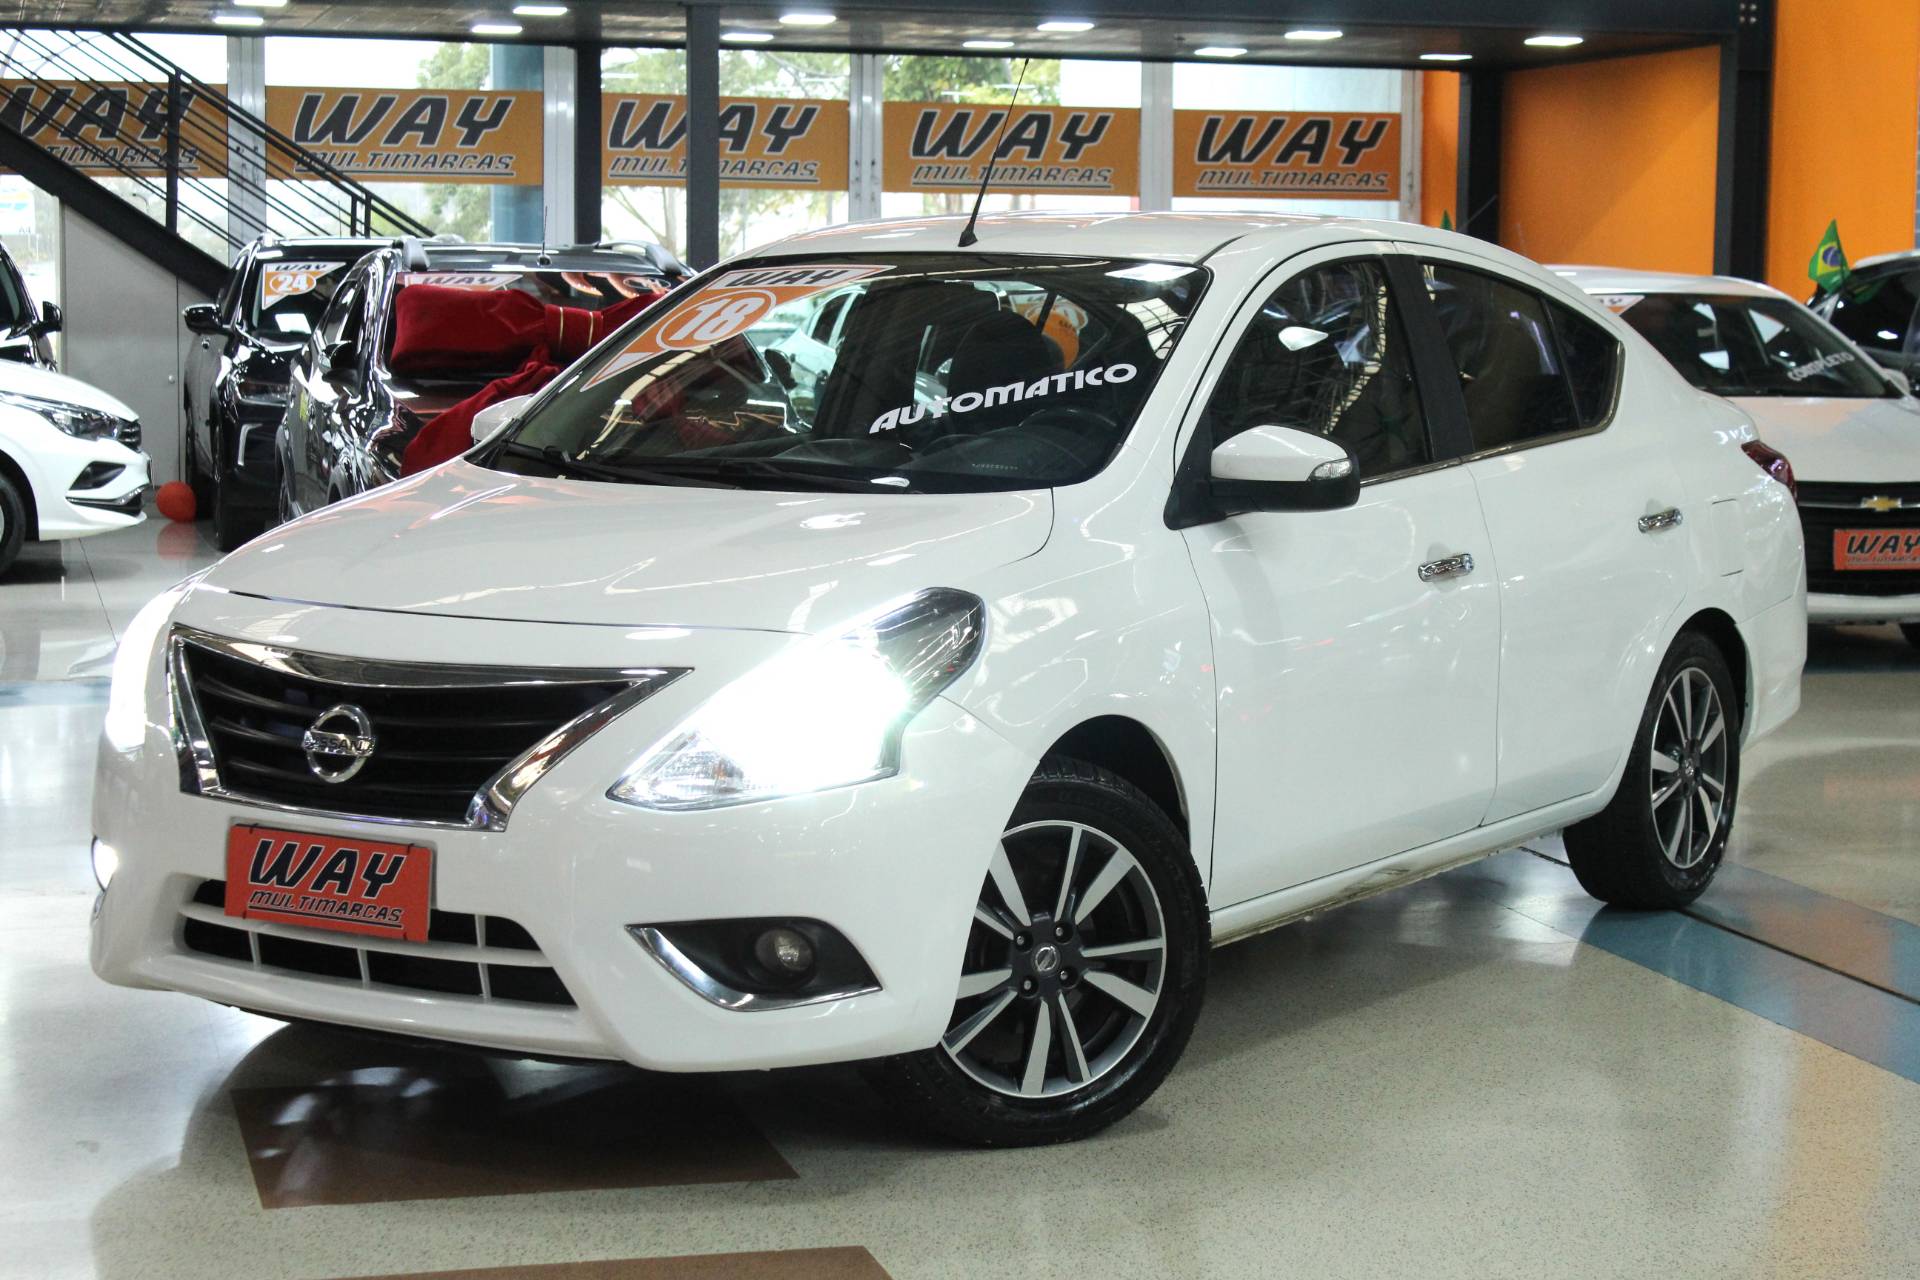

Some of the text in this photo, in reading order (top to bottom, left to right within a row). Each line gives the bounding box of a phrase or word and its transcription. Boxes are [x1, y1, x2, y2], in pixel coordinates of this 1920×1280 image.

[294, 93, 516, 148] WAY
[607, 100, 821, 155] WAY
[910, 109, 1115, 162] WAY
[1196, 115, 1392, 167] WAY
[911, 163, 1113, 184] MULTIMARCAS
[1197, 169, 1389, 187] MULTIMARCAS
[277, 273, 308, 292] 24
[723, 269, 850, 287] WAY
[668, 297, 766, 342] 18
[869, 363, 1138, 434] AUTOMATICO
[1847, 534, 1920, 554] WAY
[249, 839, 406, 899] WAY
[249, 890, 404, 922] MULTIMARCAS
